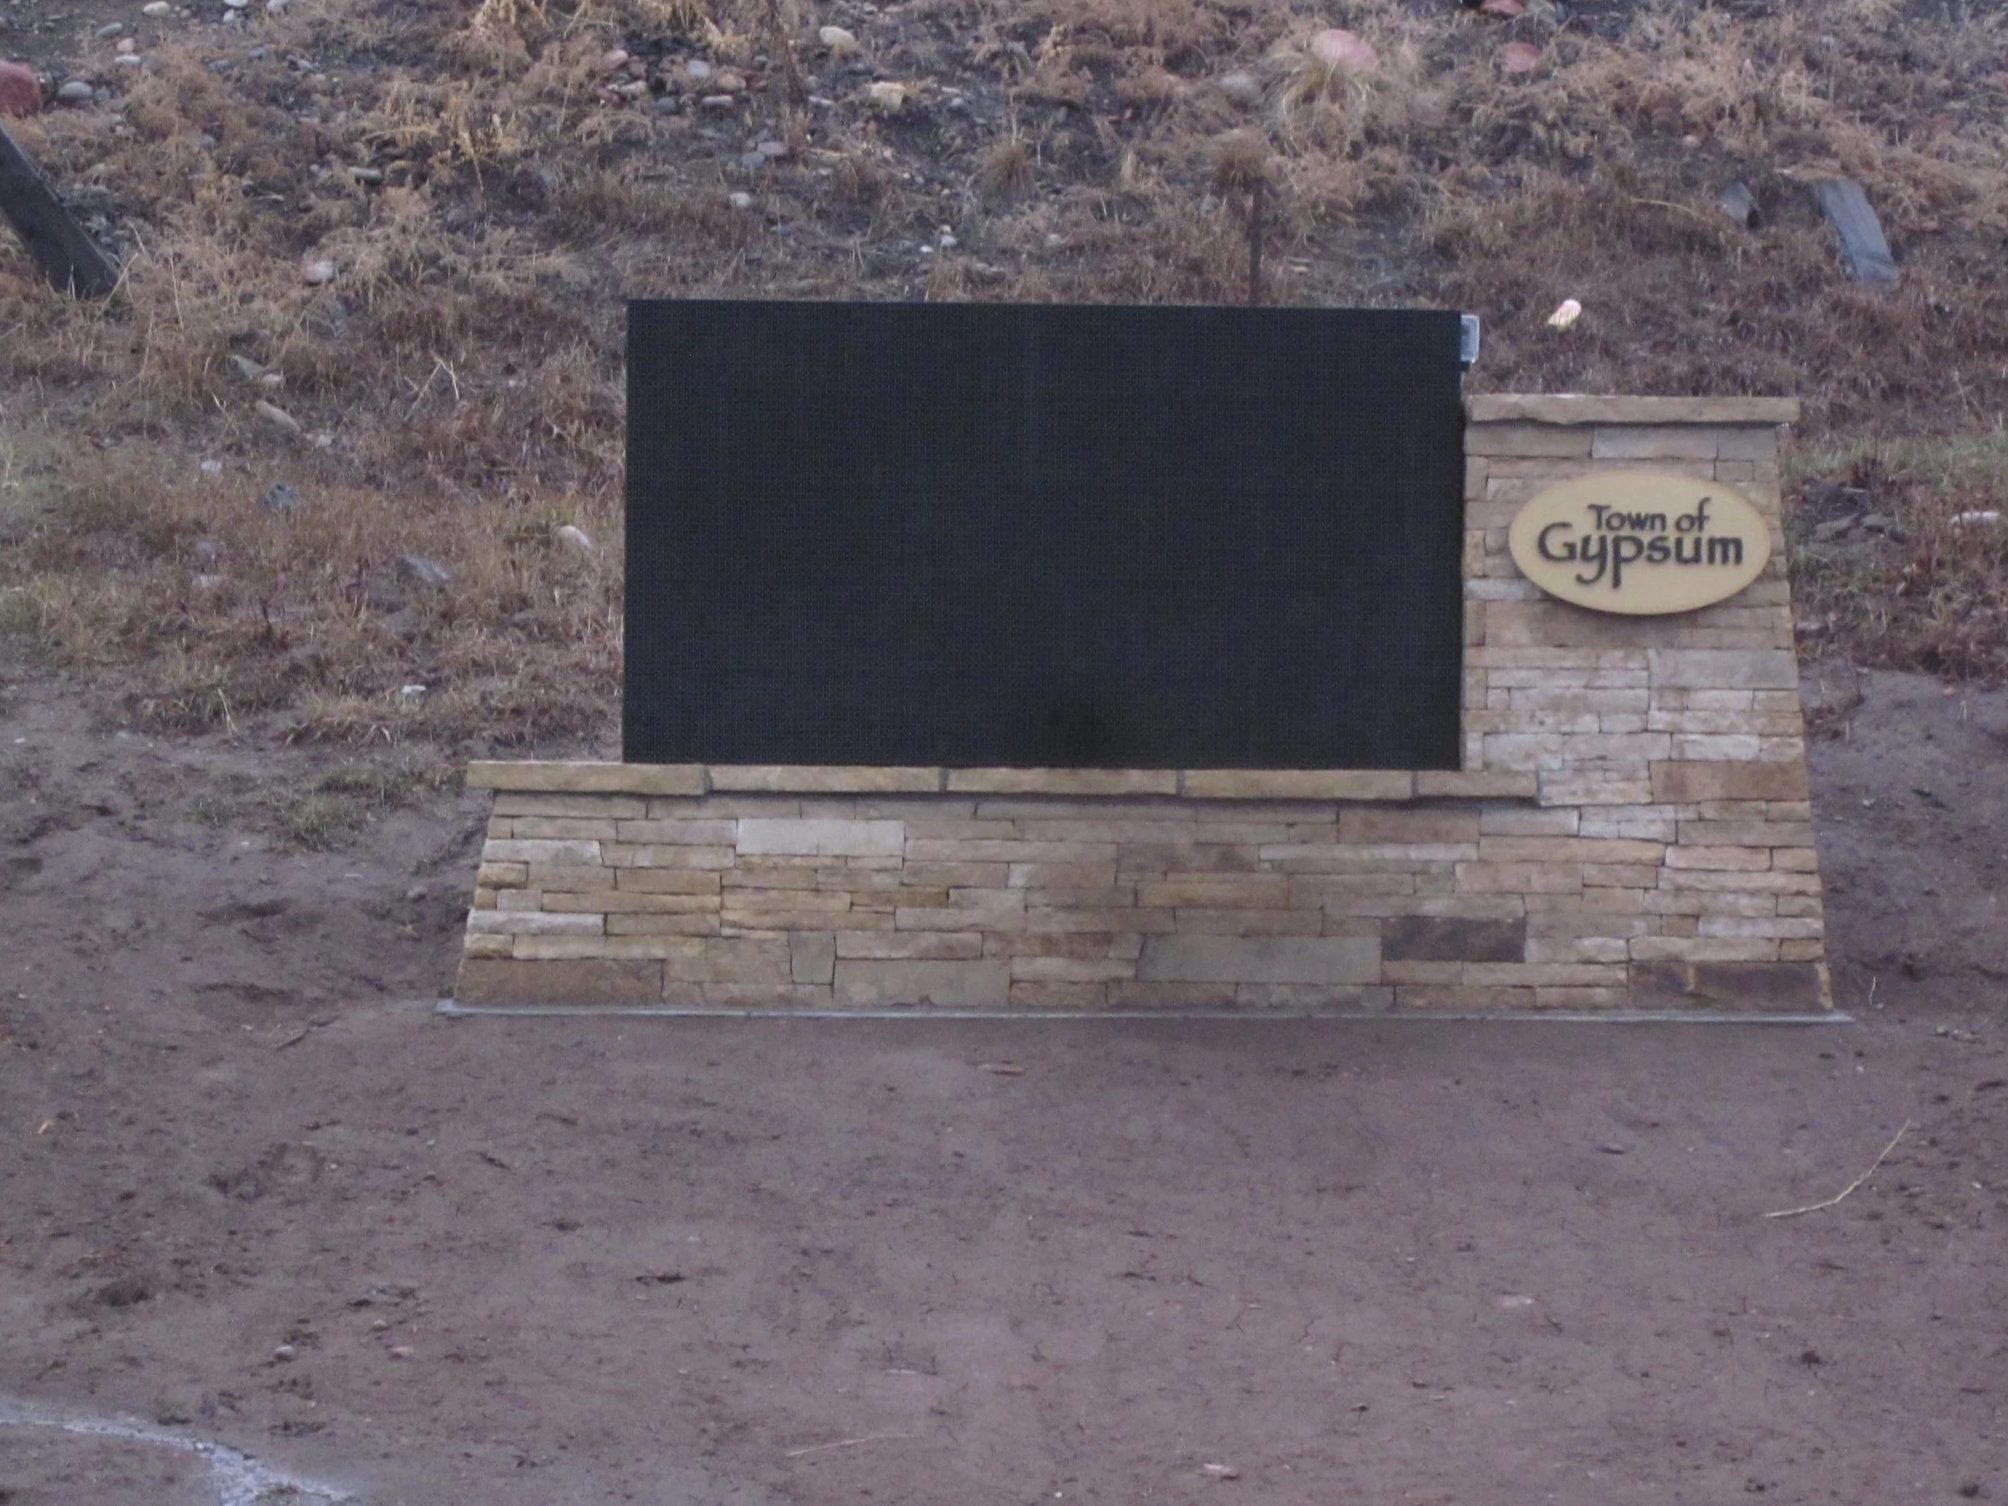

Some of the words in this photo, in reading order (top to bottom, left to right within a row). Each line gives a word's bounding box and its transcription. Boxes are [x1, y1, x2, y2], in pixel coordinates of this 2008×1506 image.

[1587, 503, 1667, 532] Town
[1675, 497, 1712, 532] of
[1537, 521, 1744, 589] Gypsum
